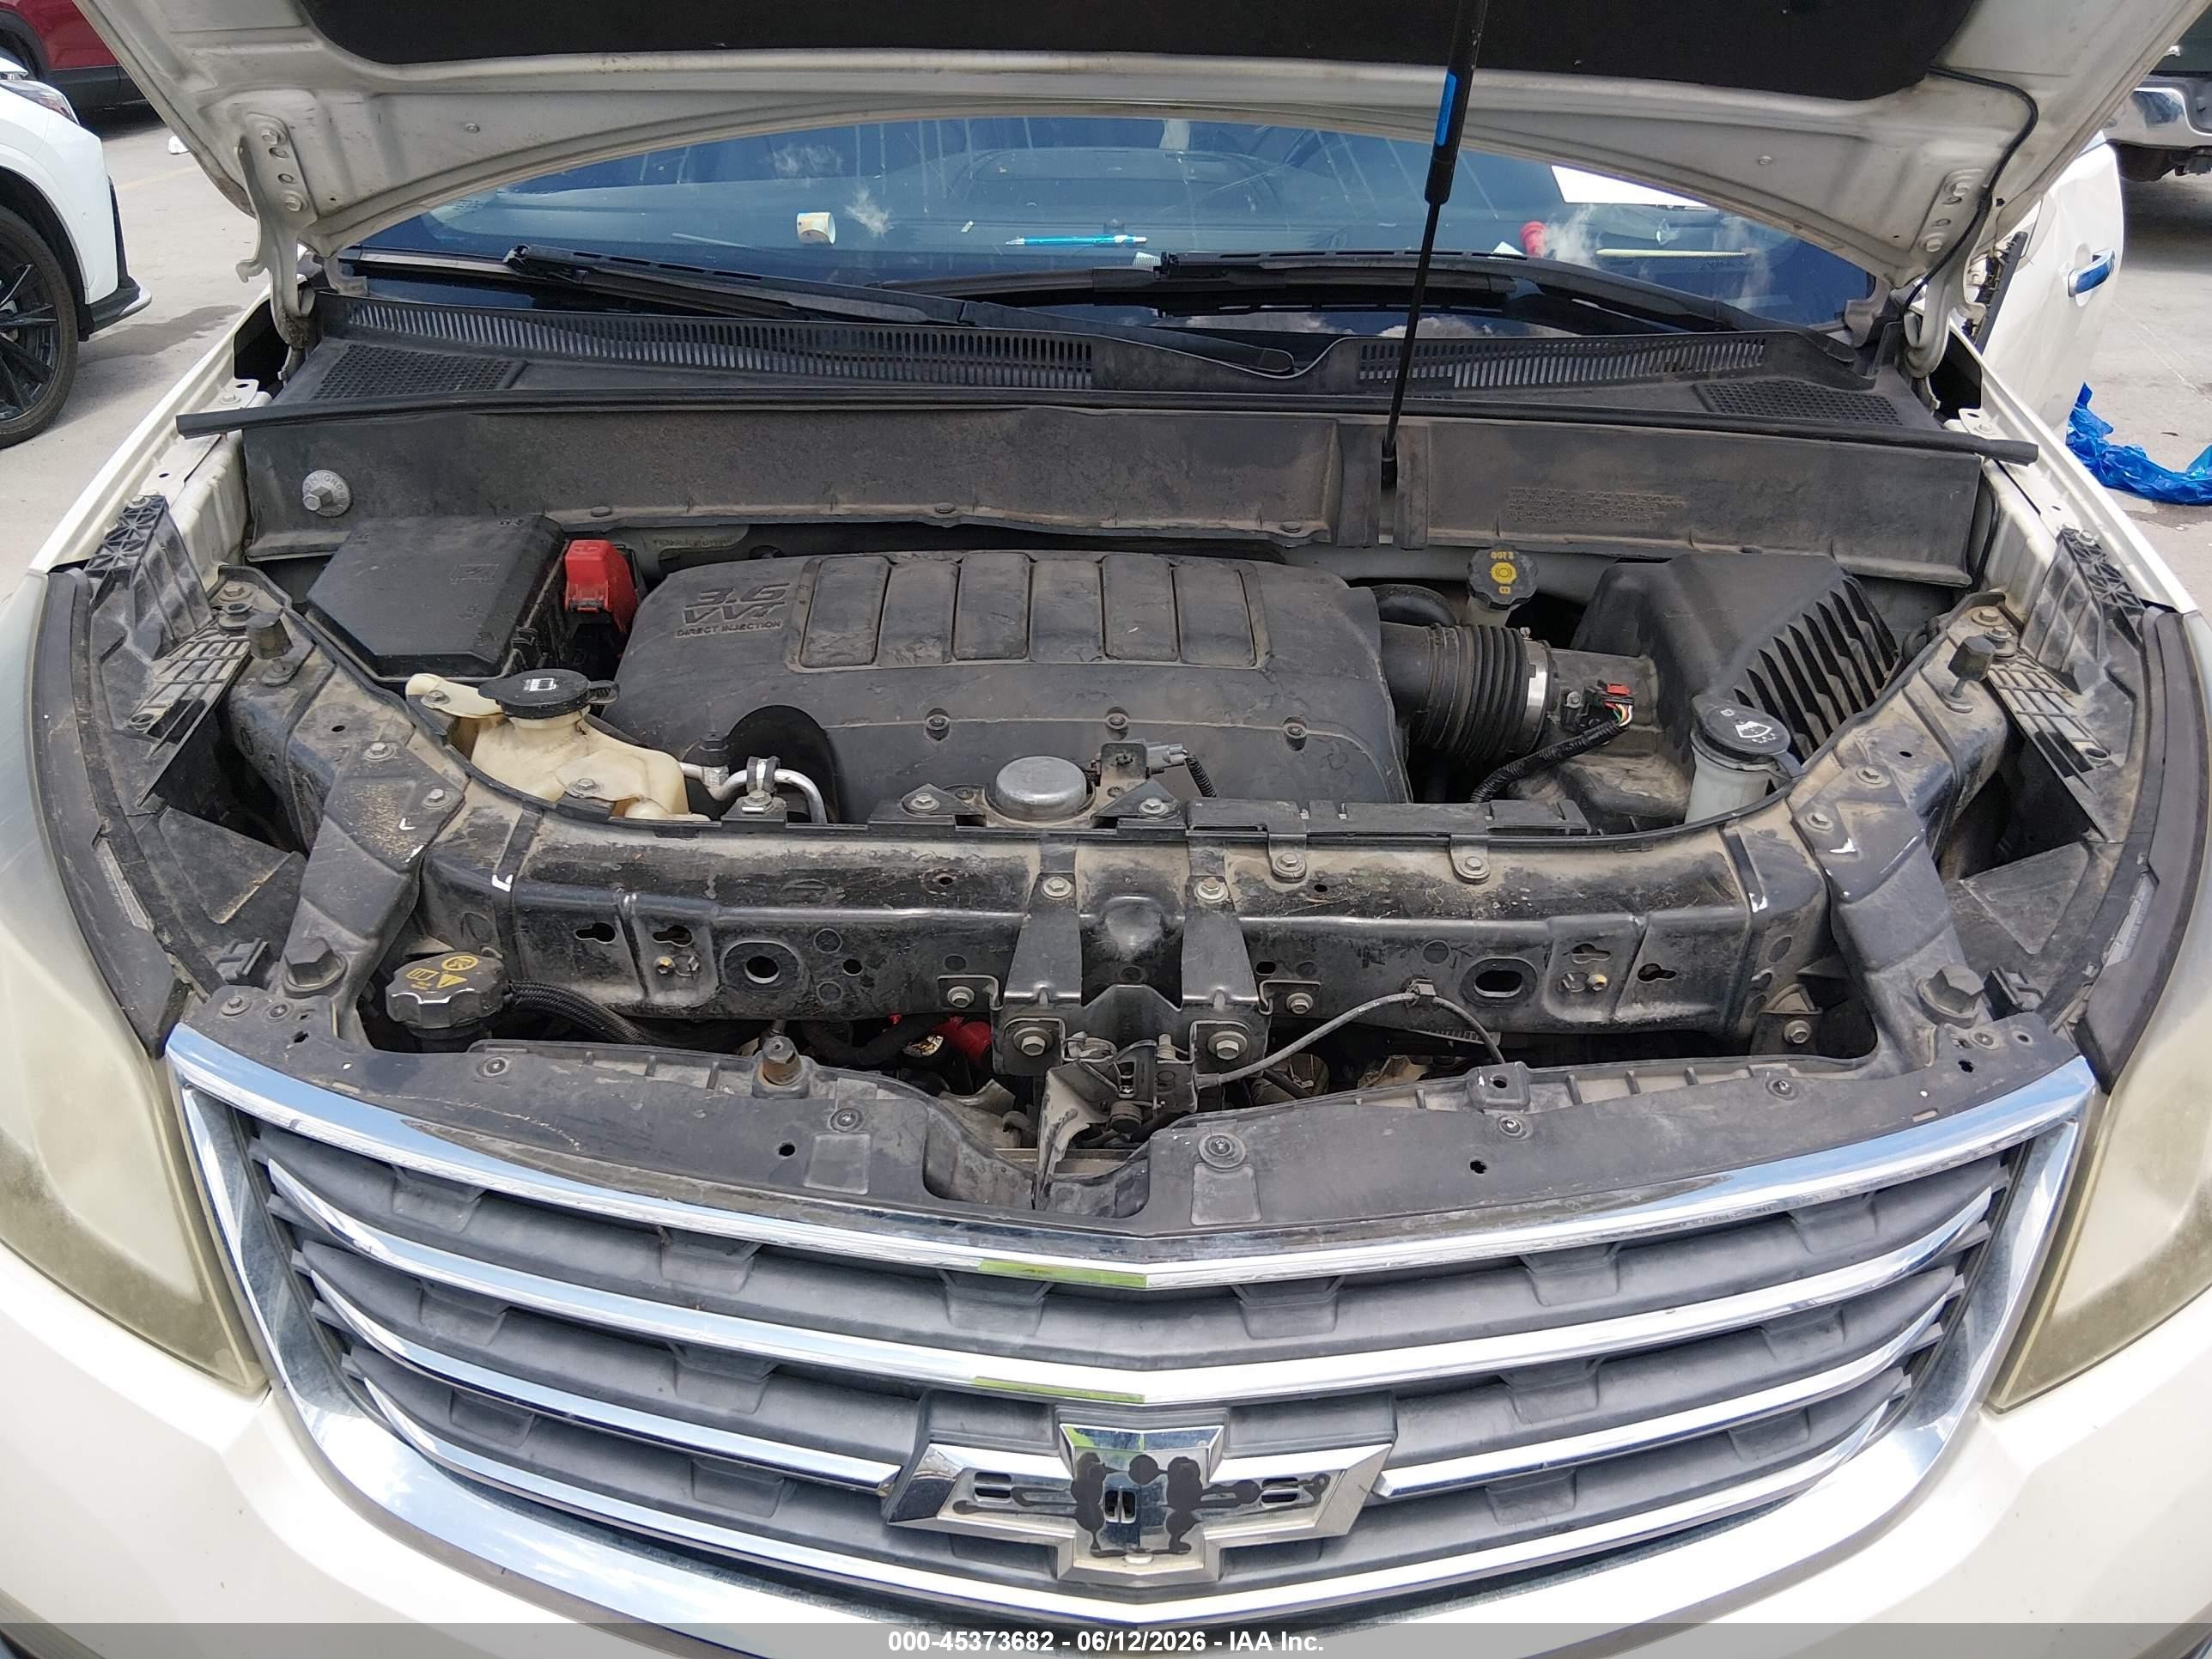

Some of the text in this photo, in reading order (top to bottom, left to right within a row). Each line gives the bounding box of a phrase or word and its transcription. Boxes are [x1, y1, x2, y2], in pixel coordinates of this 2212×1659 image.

[685, 582, 790, 608] 3.6
[676, 620, 781, 637] DIRECT INJECTION
